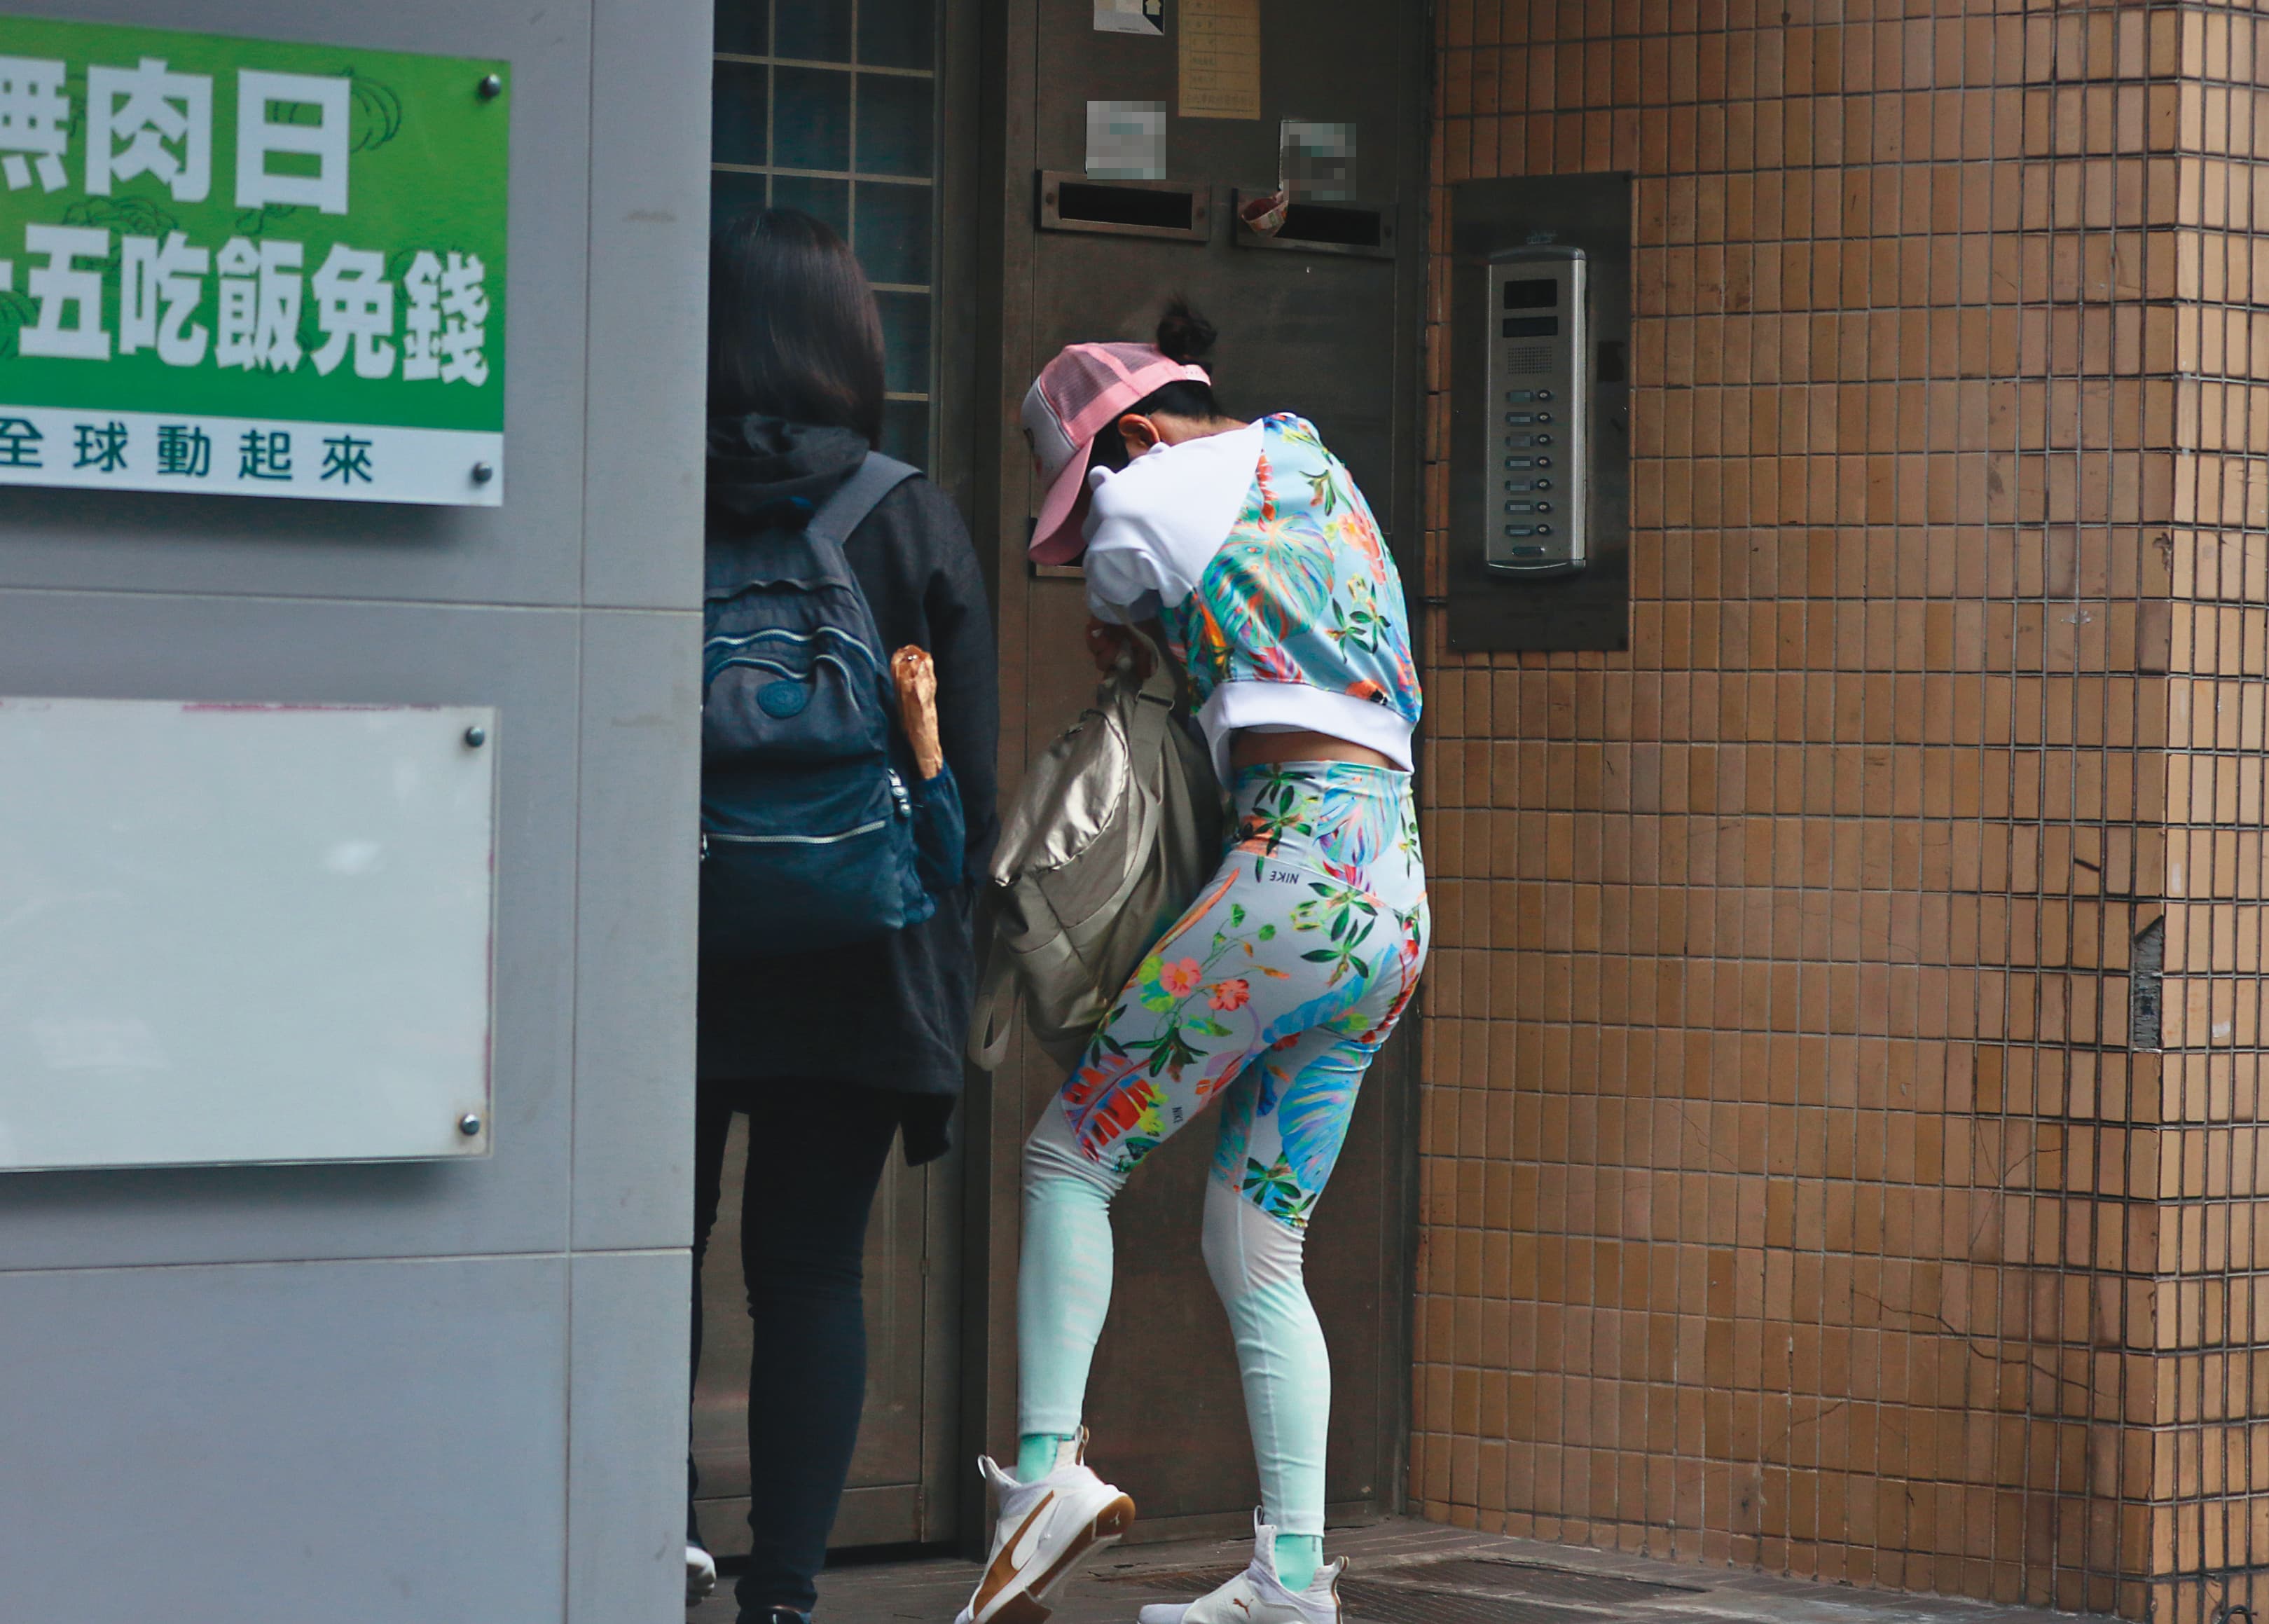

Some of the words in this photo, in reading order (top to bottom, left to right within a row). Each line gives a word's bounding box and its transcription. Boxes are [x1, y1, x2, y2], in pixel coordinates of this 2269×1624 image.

[0, 223, 488, 387] 五吃飯免錢
[0, 418, 373, 485] 全球動起來
[1269, 870, 1299, 884] NIKE
